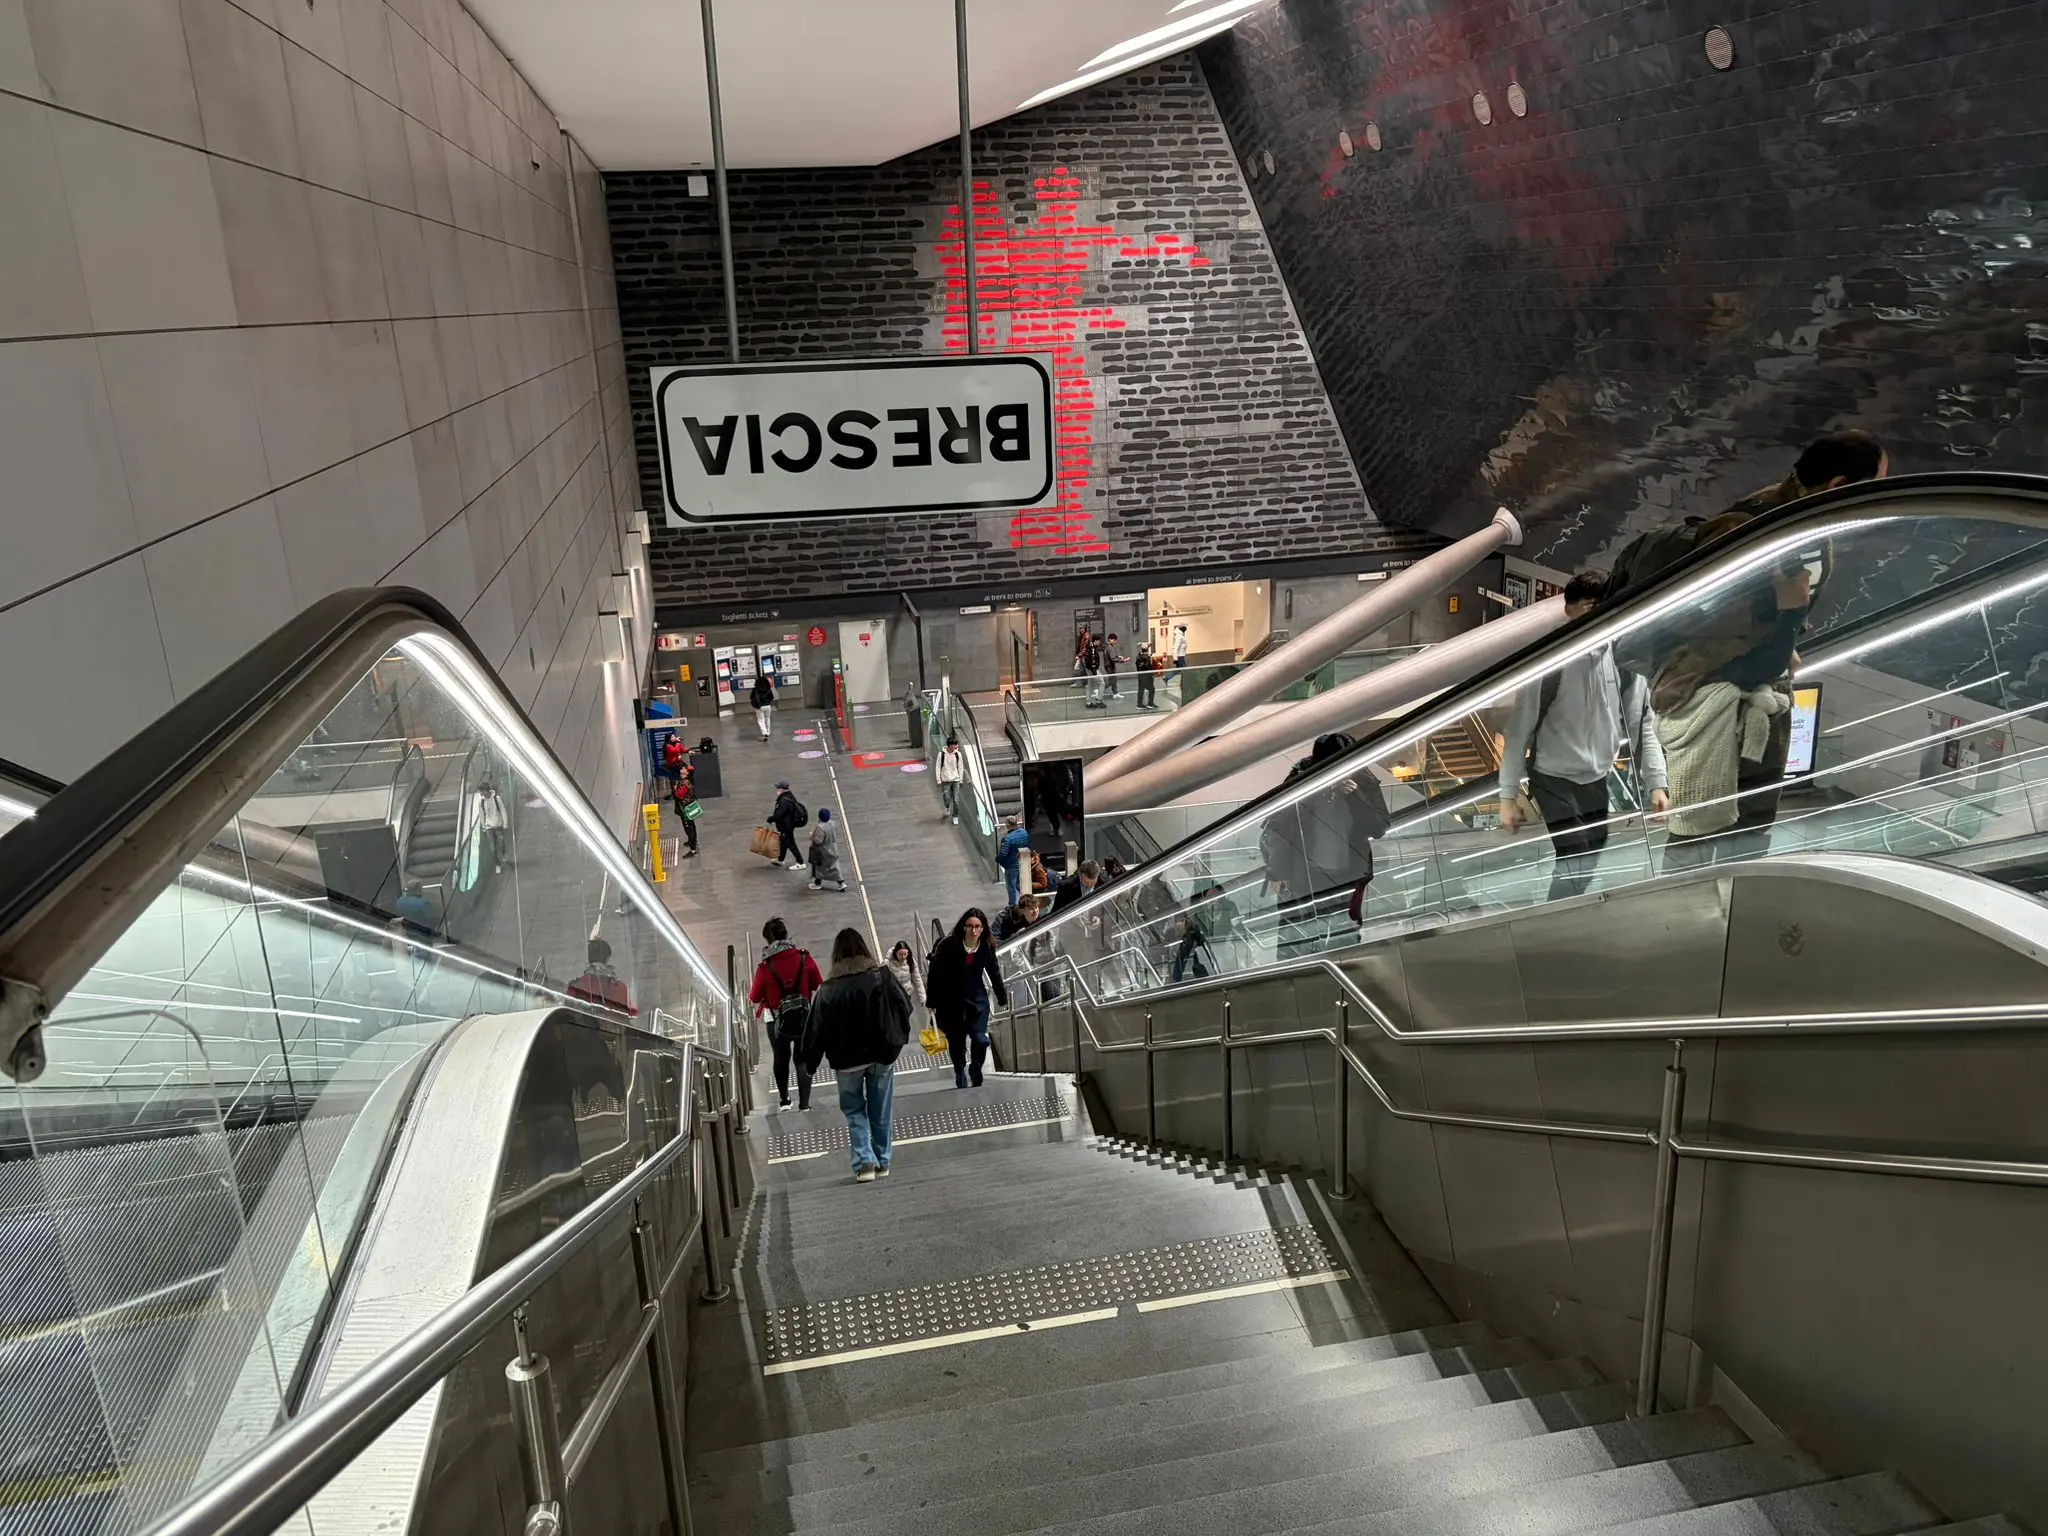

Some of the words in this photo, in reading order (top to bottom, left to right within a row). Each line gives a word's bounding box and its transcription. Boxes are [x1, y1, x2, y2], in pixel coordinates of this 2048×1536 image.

[681, 403, 1031, 476] BRESCIA
[1389, 560, 1403, 568] treni
[1193, 575, 1207, 585] treni
[991, 591, 1006, 601] treni
[748, 611, 768, 620] tickets
